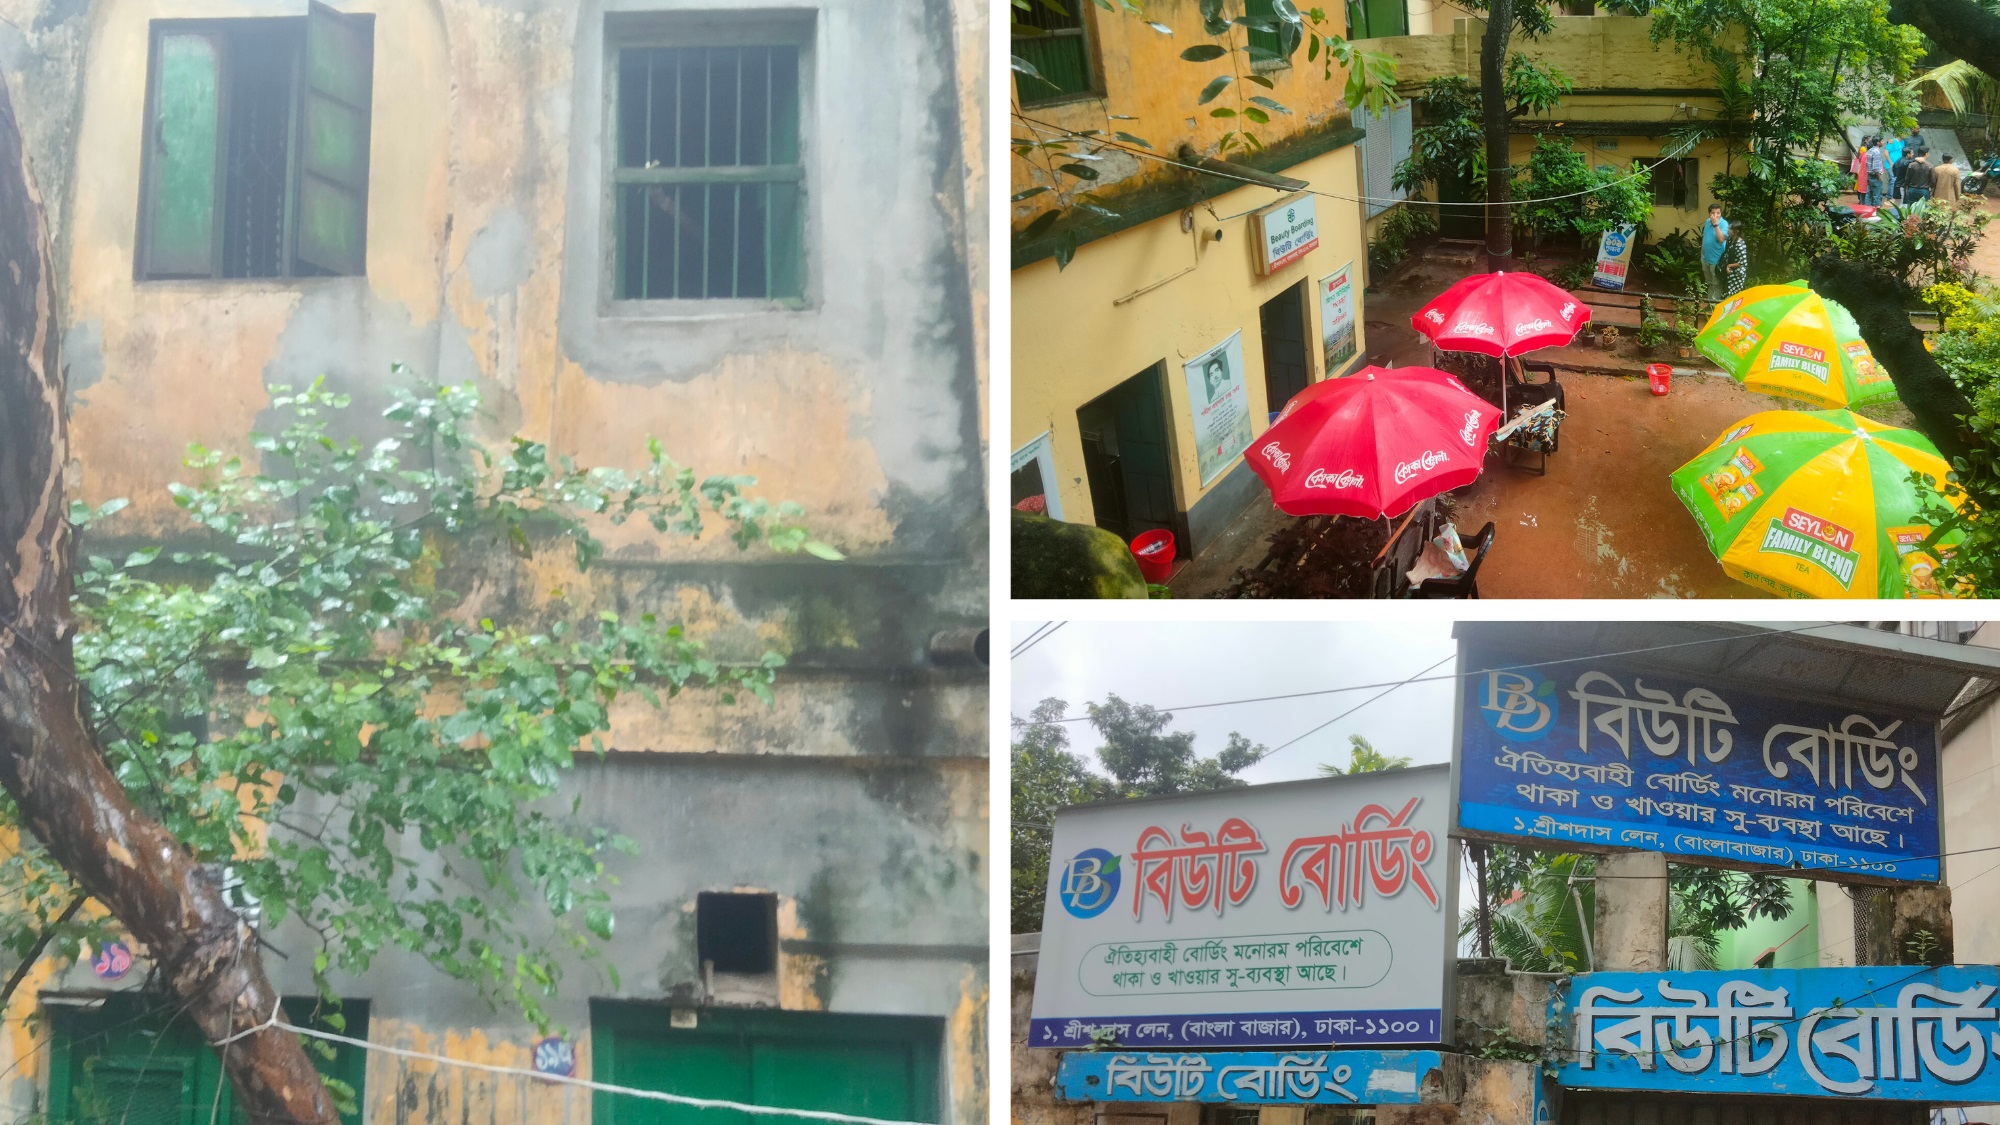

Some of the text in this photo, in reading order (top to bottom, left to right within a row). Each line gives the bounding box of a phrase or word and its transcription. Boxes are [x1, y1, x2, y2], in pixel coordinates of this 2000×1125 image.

[1270, 217, 1314, 245] Beauty Boarding
[1770, 354, 1828, 382] FAMILY BLEND
[1782, 342, 1823, 361] SEYLON
[1788, 512, 1849, 548] SEYLON
[1763, 526, 1854, 584] FAMILY BLEND
[1795, 562, 1810, 574] TEA
[1567, 671, 1928, 804] বিউটি বোর্ডিং
[1494, 746, 1915, 824] ঐতিহ্যবাহী বোর্ডিং মনোরম পরিবেশে
[1516, 783, 1580, 808] থাকা
[1590, 795, 1614, 810] ও
[1626, 796, 1716, 824] খাওয়ার
[1620, 829, 1665, 849] লেন,
[1130, 797, 1438, 918] বিউটি বোর্ডিং
[1104, 935, 1364, 965] ঐতিহ্যবাহী বোর্ডিং মনোরম পরিবেশে
[1113, 971, 1145, 988] থাকা
[1150, 972, 1161, 985] ও
[1168, 968, 1221, 986] খাওয়ার
[1043, 1025, 1058, 1042] ১,
[1136, 1022, 1174, 1041] লেন,
[1181, 1020, 1236, 1041] (বাংলা
[1239, 1017, 1307, 1039] বাজার),
[1314, 1017, 1420, 1036] ঢাকা-১১০০
[1572, 980, 2000, 1095] বিউটি বোর্ডি
[1106, 1054, 1213, 1097] বিউটি
[1217, 1054, 1358, 1102] বোর্ডিং
